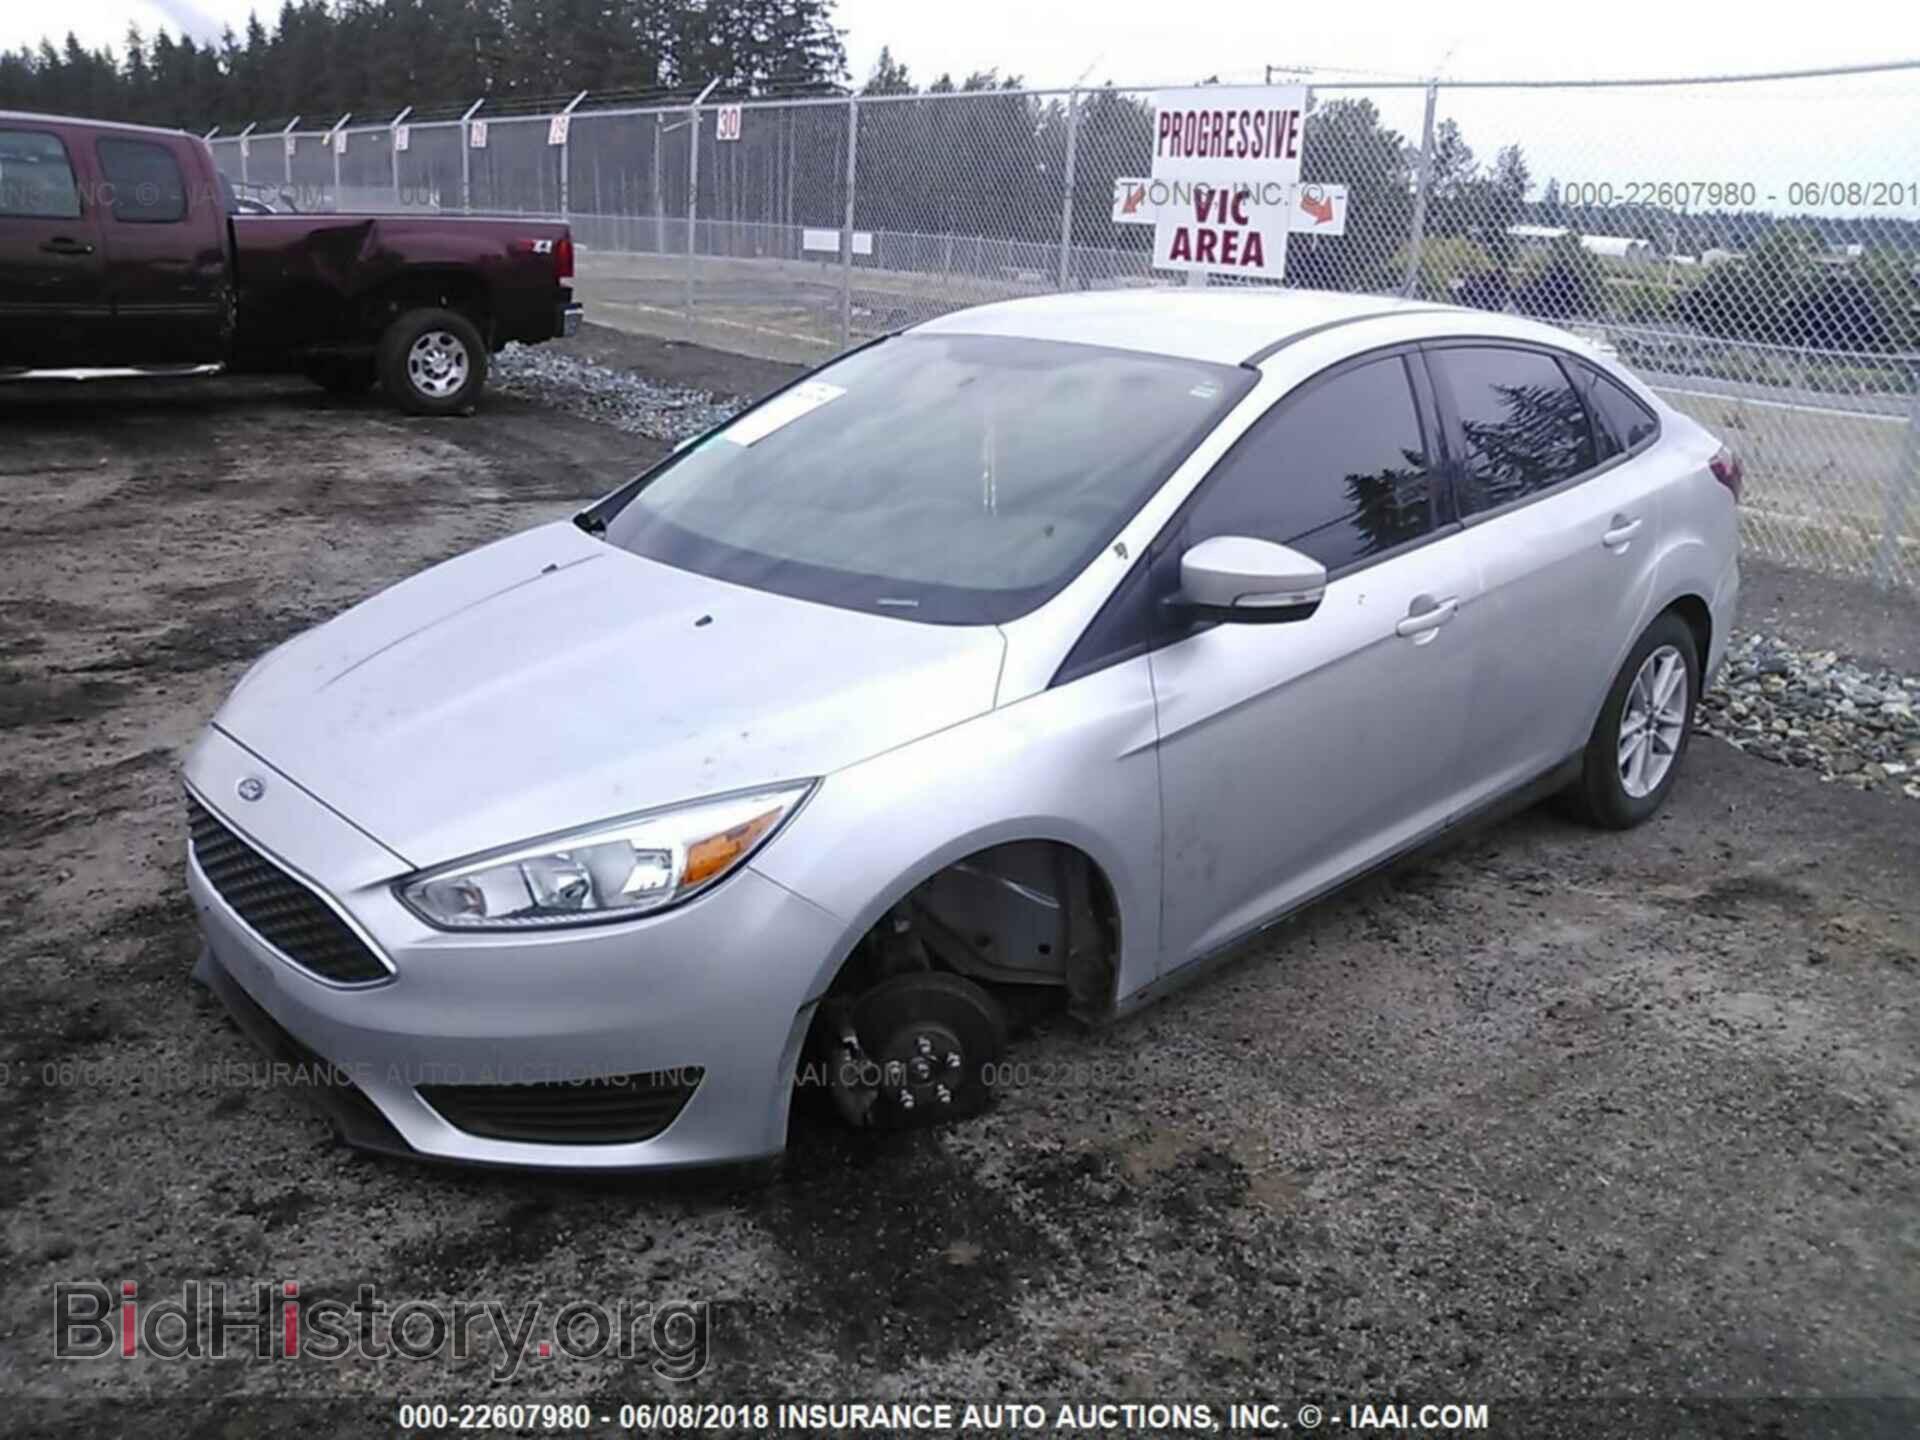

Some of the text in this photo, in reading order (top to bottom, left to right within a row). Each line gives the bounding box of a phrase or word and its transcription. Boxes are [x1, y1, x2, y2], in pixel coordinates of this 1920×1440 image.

[719, 108, 738, 138] 30
[1156, 109, 1300, 159] PROGRESSIVE
[1193, 188, 1250, 226] VIC
[1169, 227, 1264, 268] AREA
